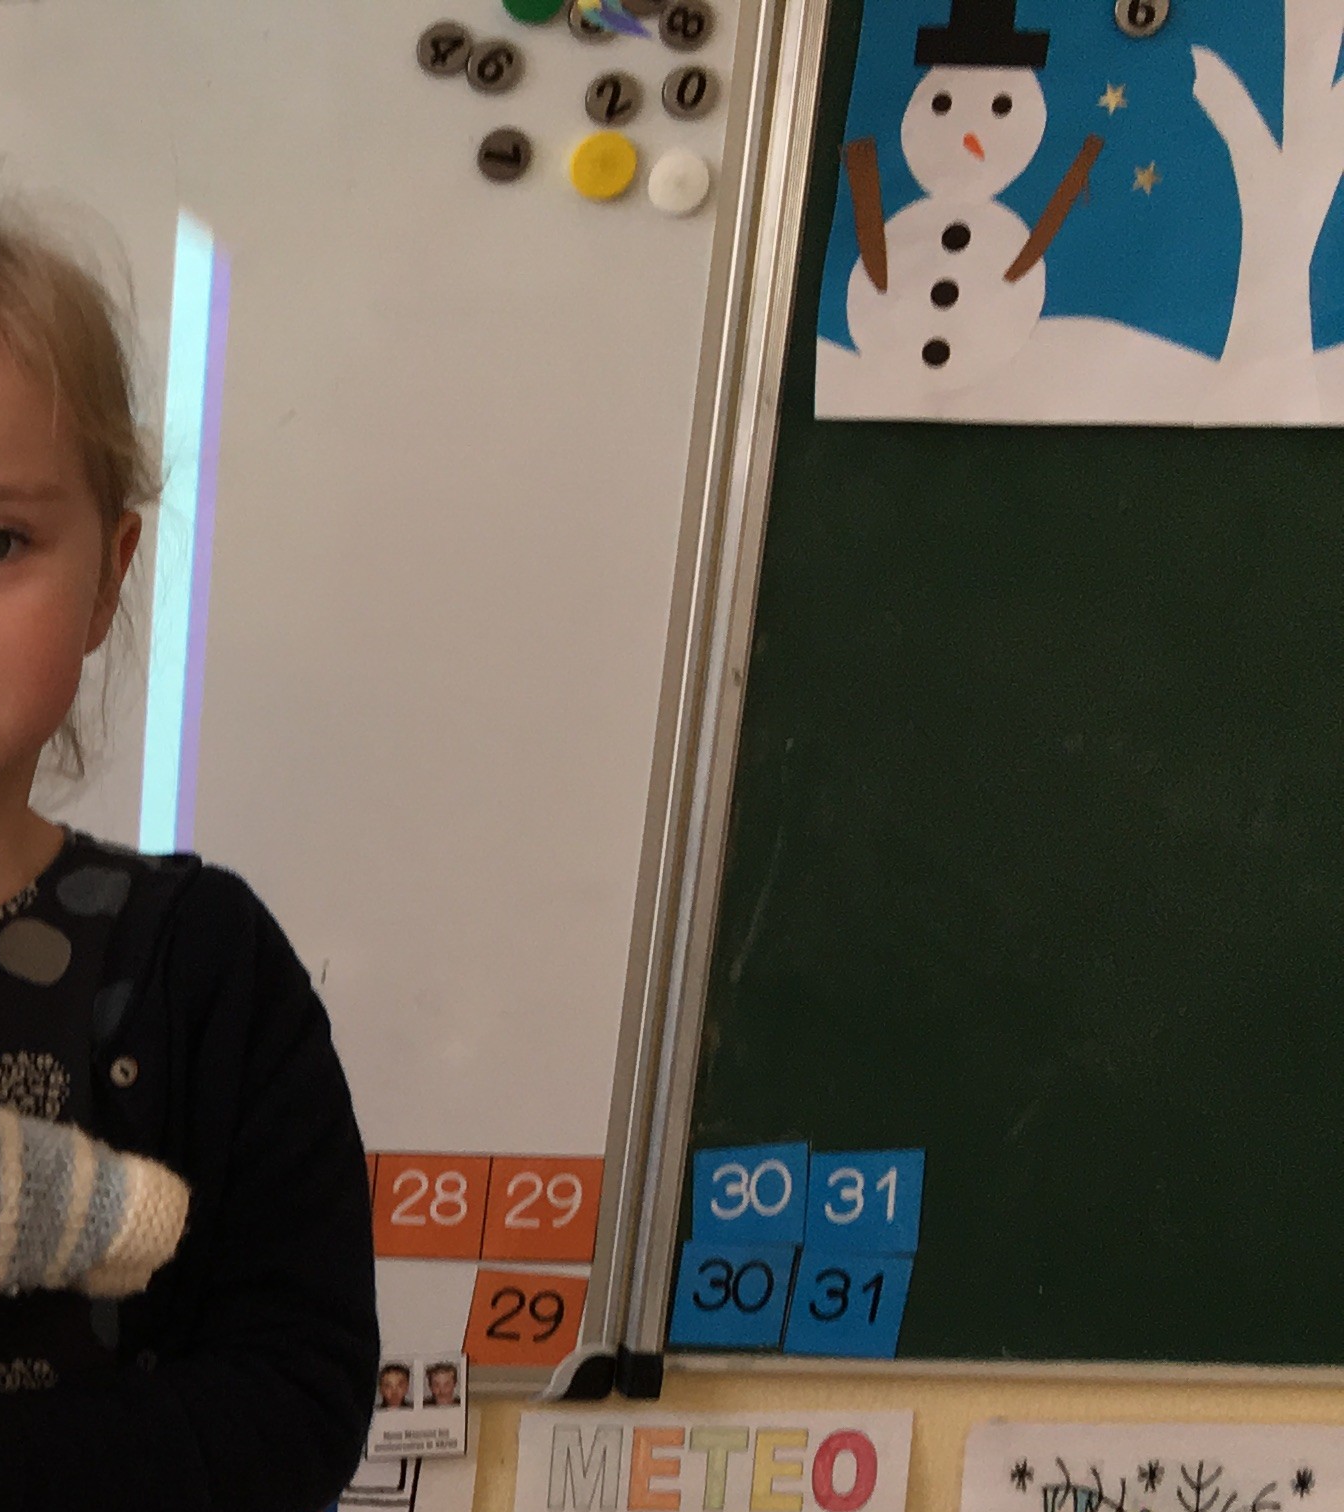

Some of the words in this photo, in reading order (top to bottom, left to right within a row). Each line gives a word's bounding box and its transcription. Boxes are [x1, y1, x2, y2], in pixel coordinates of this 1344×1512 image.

[390, 1169, 468, 1227] 28
[504, 1171, 583, 1229] 29
[711, 1158, 793, 1220] 30
[825, 1166, 899, 1226] 31
[486, 1286, 565, 1343] 29
[692, 1258, 774, 1313] 30
[809, 1267, 886, 1325] 31
